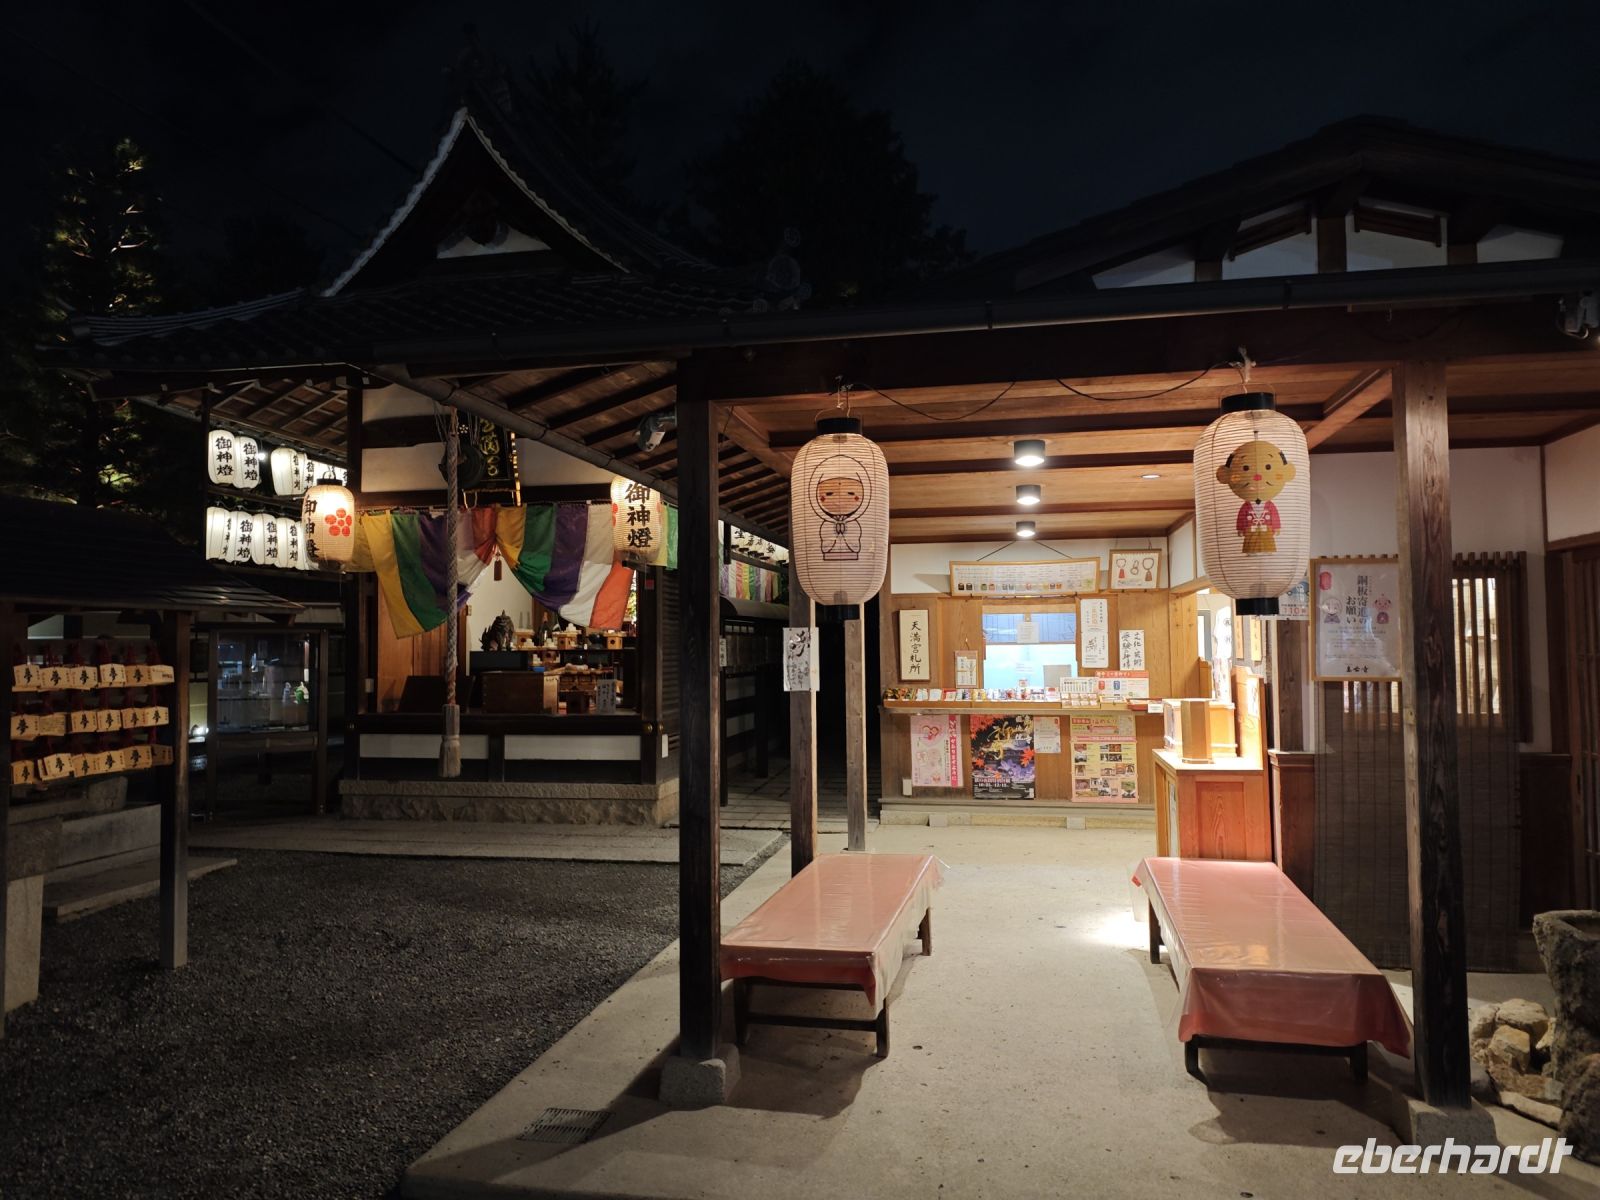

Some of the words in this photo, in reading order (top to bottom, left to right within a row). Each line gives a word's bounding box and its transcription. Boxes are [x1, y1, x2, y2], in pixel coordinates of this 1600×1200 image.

[215, 436, 234, 477] 御神燈
[243, 442, 258, 481] 御神燈
[624, 482, 654, 549] 御神燈
[237, 519, 252, 559] 御神燈
[1345, 596, 1357, 624] お願い
[908, 620, 922, 675] 天満宮札所
